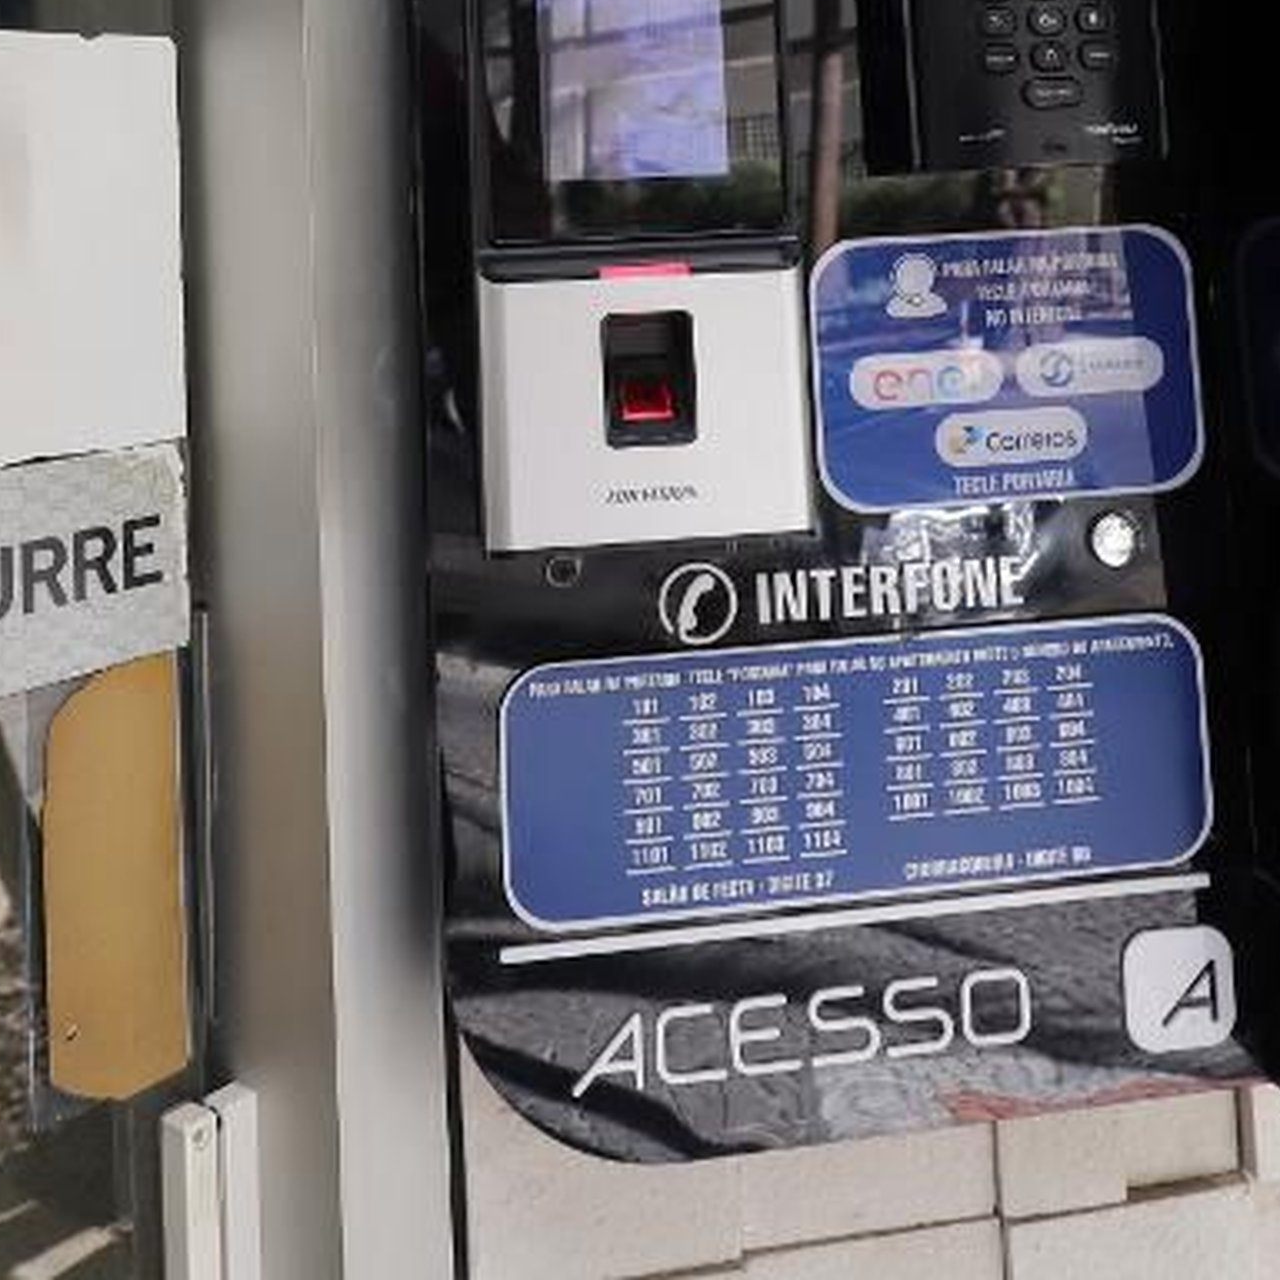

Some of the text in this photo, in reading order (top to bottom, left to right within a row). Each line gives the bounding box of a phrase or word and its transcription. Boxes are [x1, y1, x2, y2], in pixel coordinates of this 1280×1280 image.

[755, 556, 1024, 625] INTERFONE
[1162, 958, 1220, 1028] A
[572, 967, 1031, 1097] ACESSO
